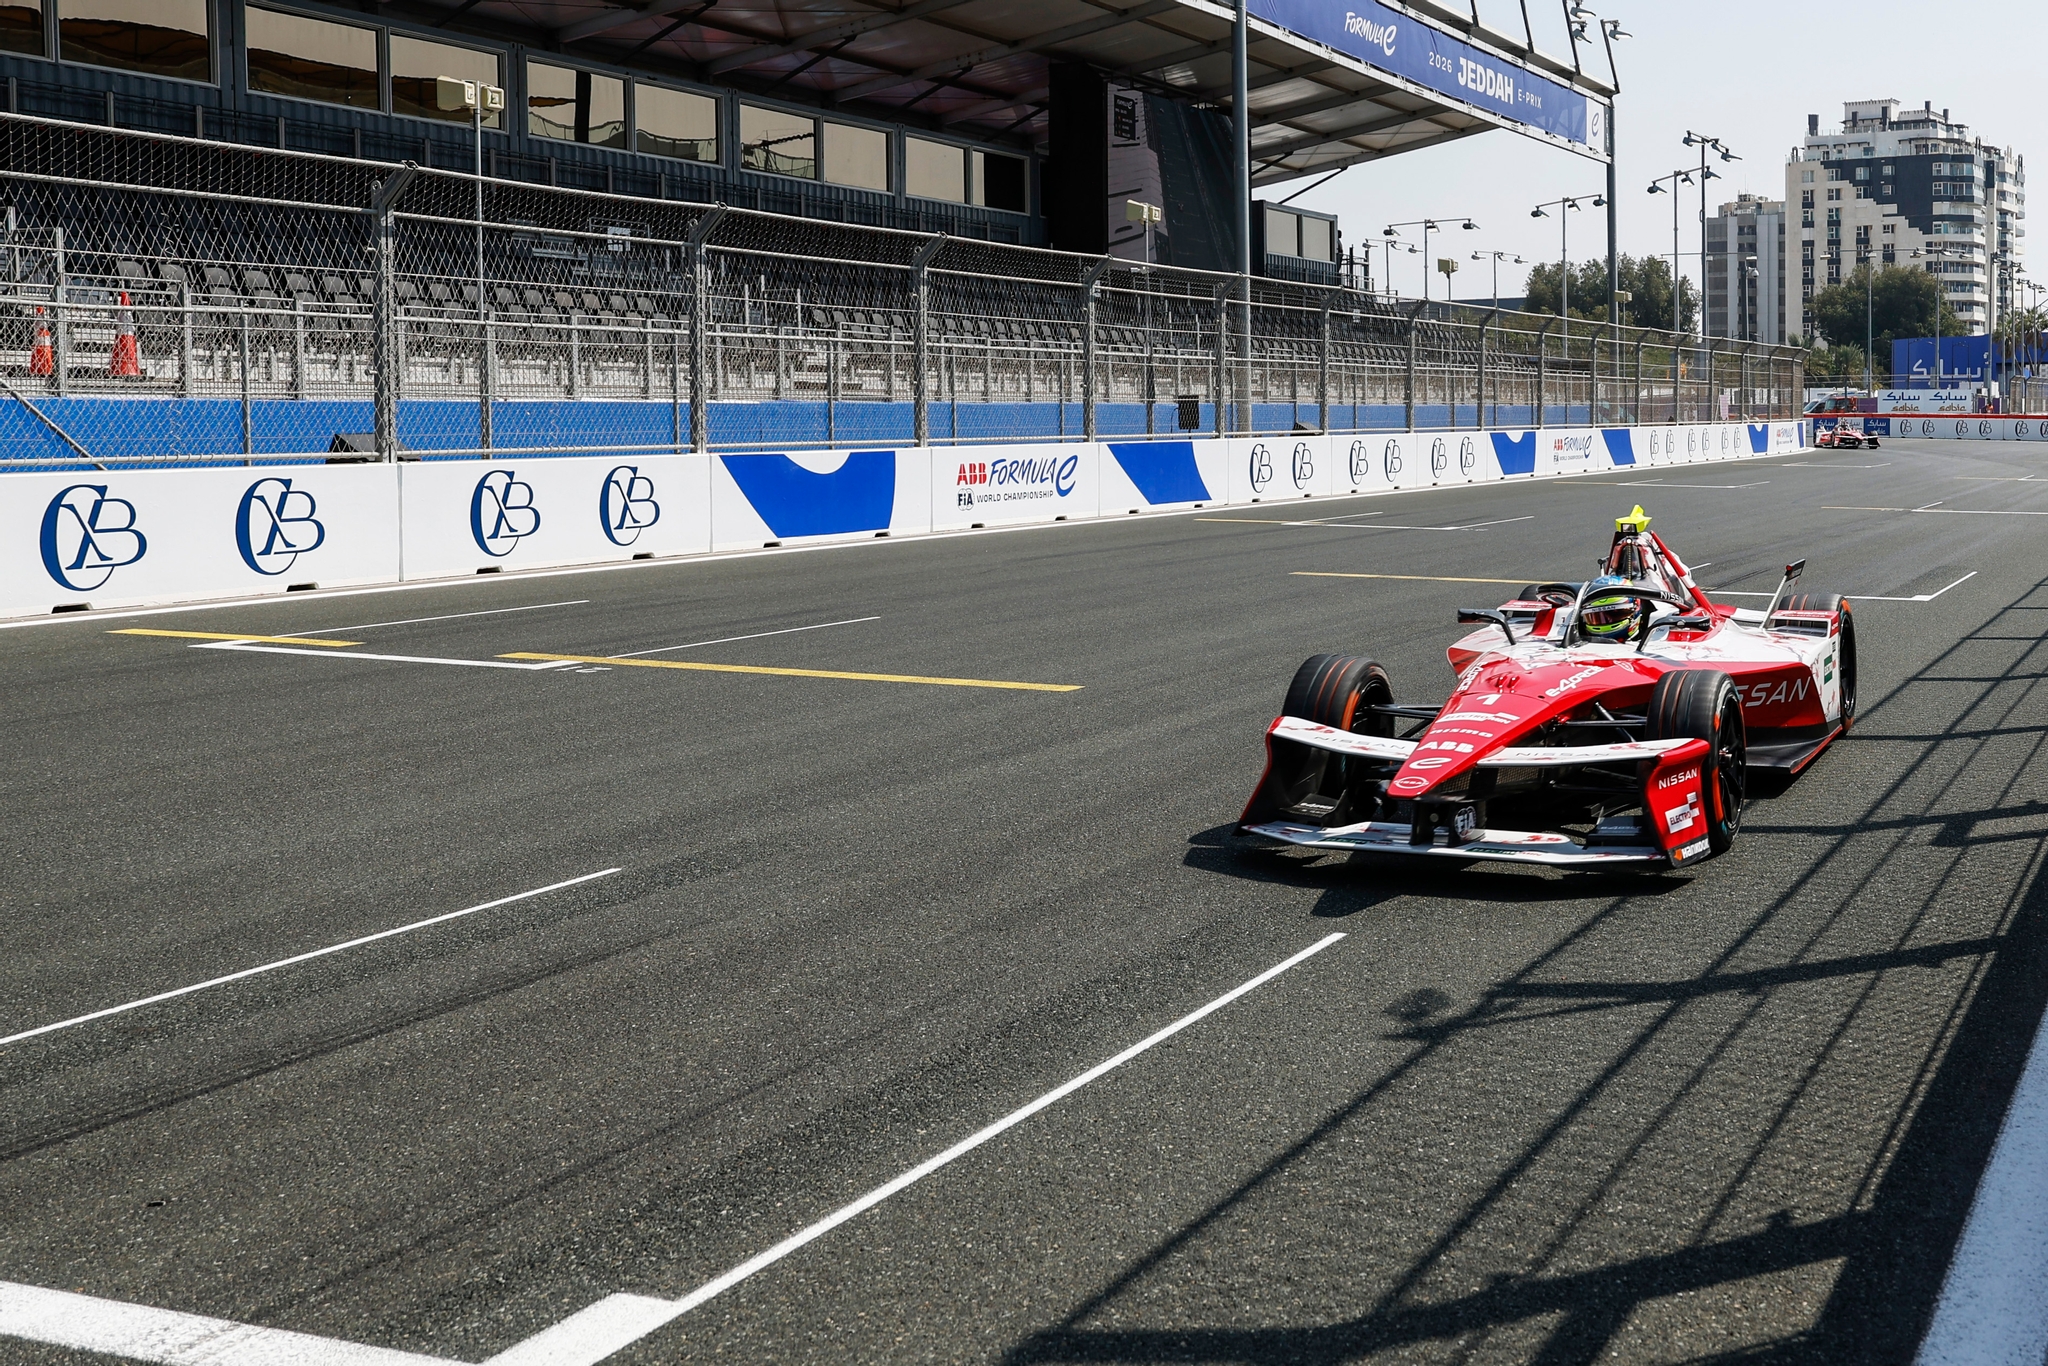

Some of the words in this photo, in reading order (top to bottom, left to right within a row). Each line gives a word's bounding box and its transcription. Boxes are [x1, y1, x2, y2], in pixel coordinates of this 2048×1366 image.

[1429, 51, 1453, 73] 2026
[1457, 57, 1514, 105] JEDDAH
[1517, 88, 1542, 109] E-PRIX
[1882, 391, 1920, 403] سابك
[1929, 391, 1967, 403] سابك
[1891, 403, 1920, 411] sabic
[1938, 403, 1967, 411] sabic
[957, 463, 987, 486] ABB
[988, 457, 1057, 487] FORMULA
[977, 494, 1001, 503] WORLD
[1004, 490, 1054, 501] CHAMPIONSHIP
[1476, 693, 1501, 706] 1
[1314, 736, 1406, 750] NISSAN
[1417, 741, 1474, 753] ABB
[1659, 768, 1698, 790] NISSAN
